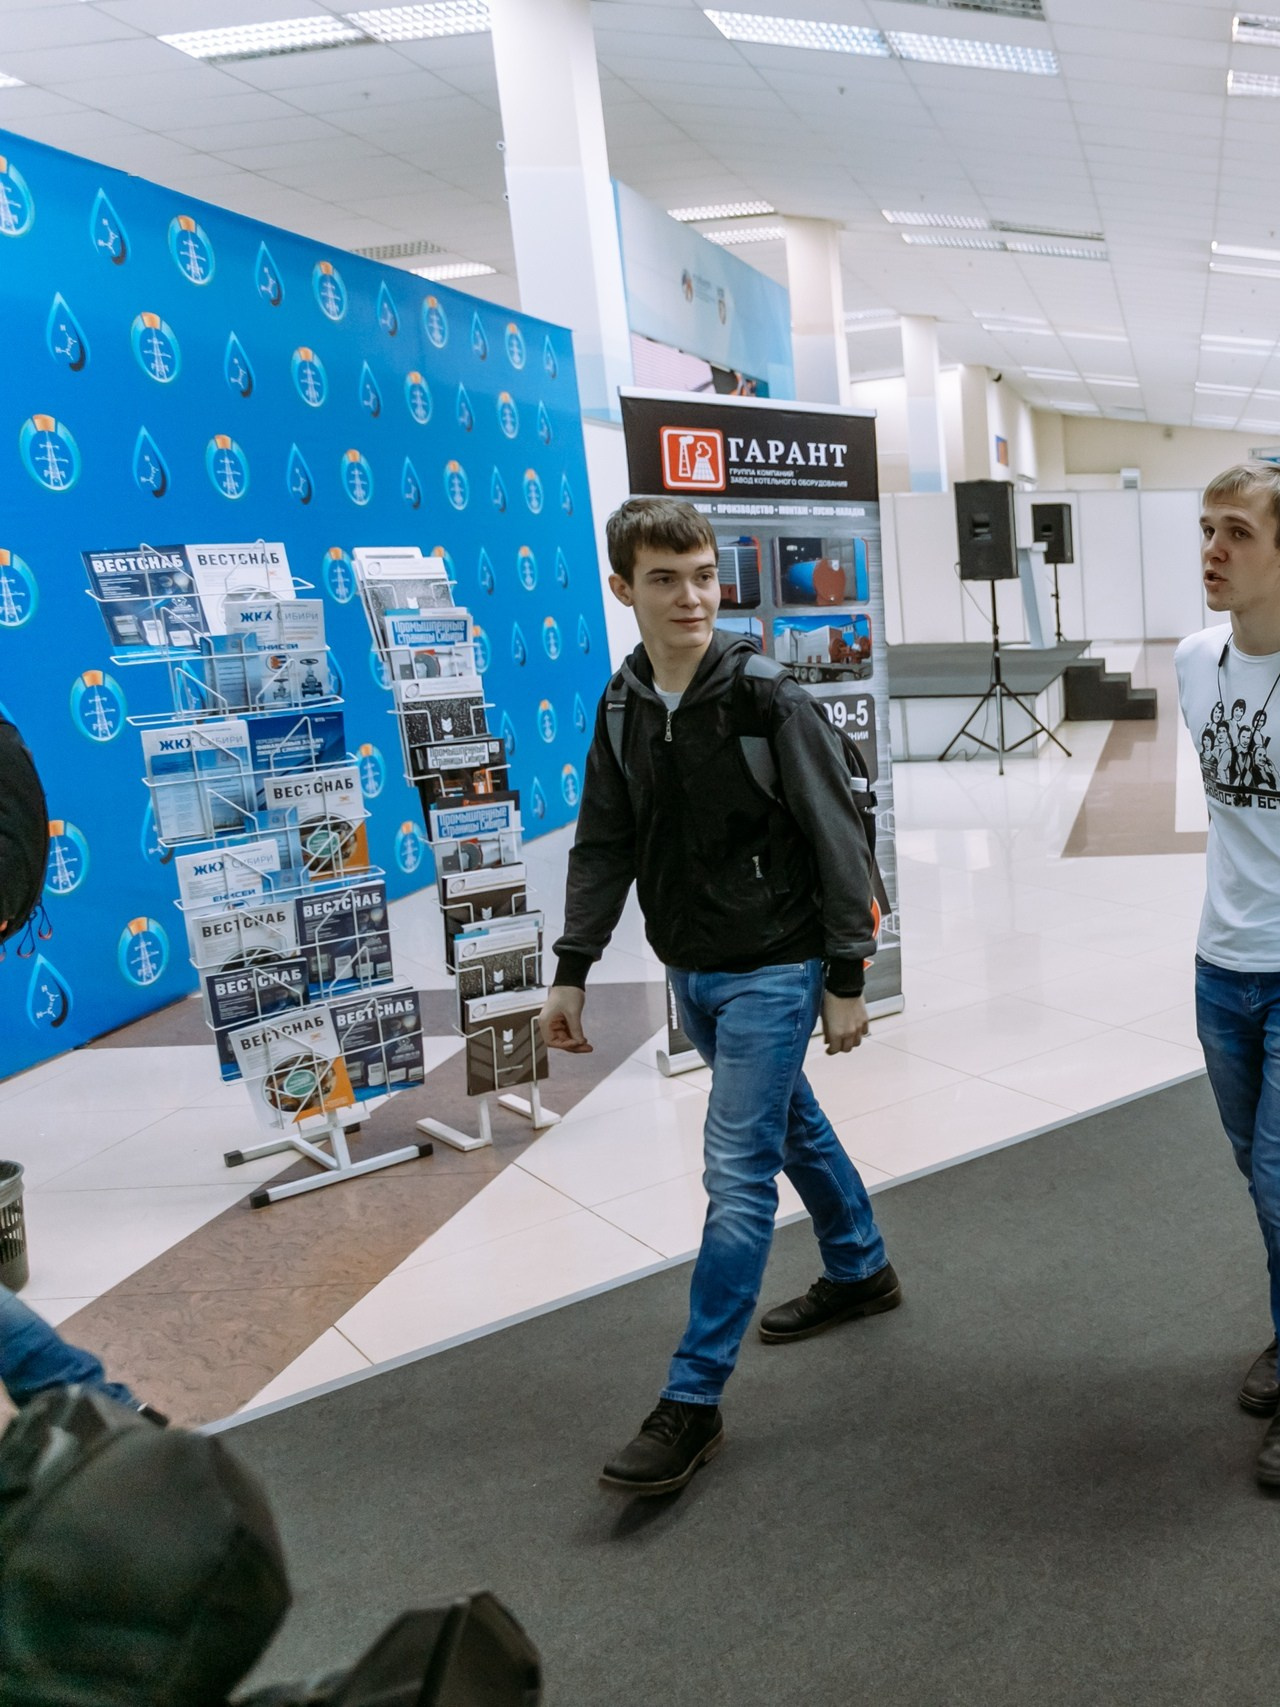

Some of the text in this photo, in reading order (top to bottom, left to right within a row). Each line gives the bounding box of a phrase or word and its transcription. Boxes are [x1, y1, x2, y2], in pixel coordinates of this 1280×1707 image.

[727, 437, 847, 467] ГАРАНТ
[729, 468, 795, 478] ГРУППА КОМПАНИЙ
[730, 476, 848, 488] ЗАВОД КОТЕЛЬНОГО ОБОРУДОВАНИЯ
[717, 503, 774, 516] ПРОИЗВОДСТВО
[92, 554, 184, 573] ВЕСТСНАБ
[197, 552, 280, 566] ВЕСТСНАБ
[240, 610, 273, 622] ЖКХ
[159, 737, 194, 751] ЖКХ
[273, 778, 354, 799] ВЕСТСНАБ
[1203, 783, 1252, 807] НОВОСИ
[302, 892, 382, 918] ВЕСТСНАБ
[201, 911, 286, 938] ВЕСТСНАБ
[214, 968, 302, 996] ВЕСТСНАБ
[336, 999, 415, 1027] ВЕСТСНАБ
[239, 1016, 325, 1050] ВЕСТСНАБ
